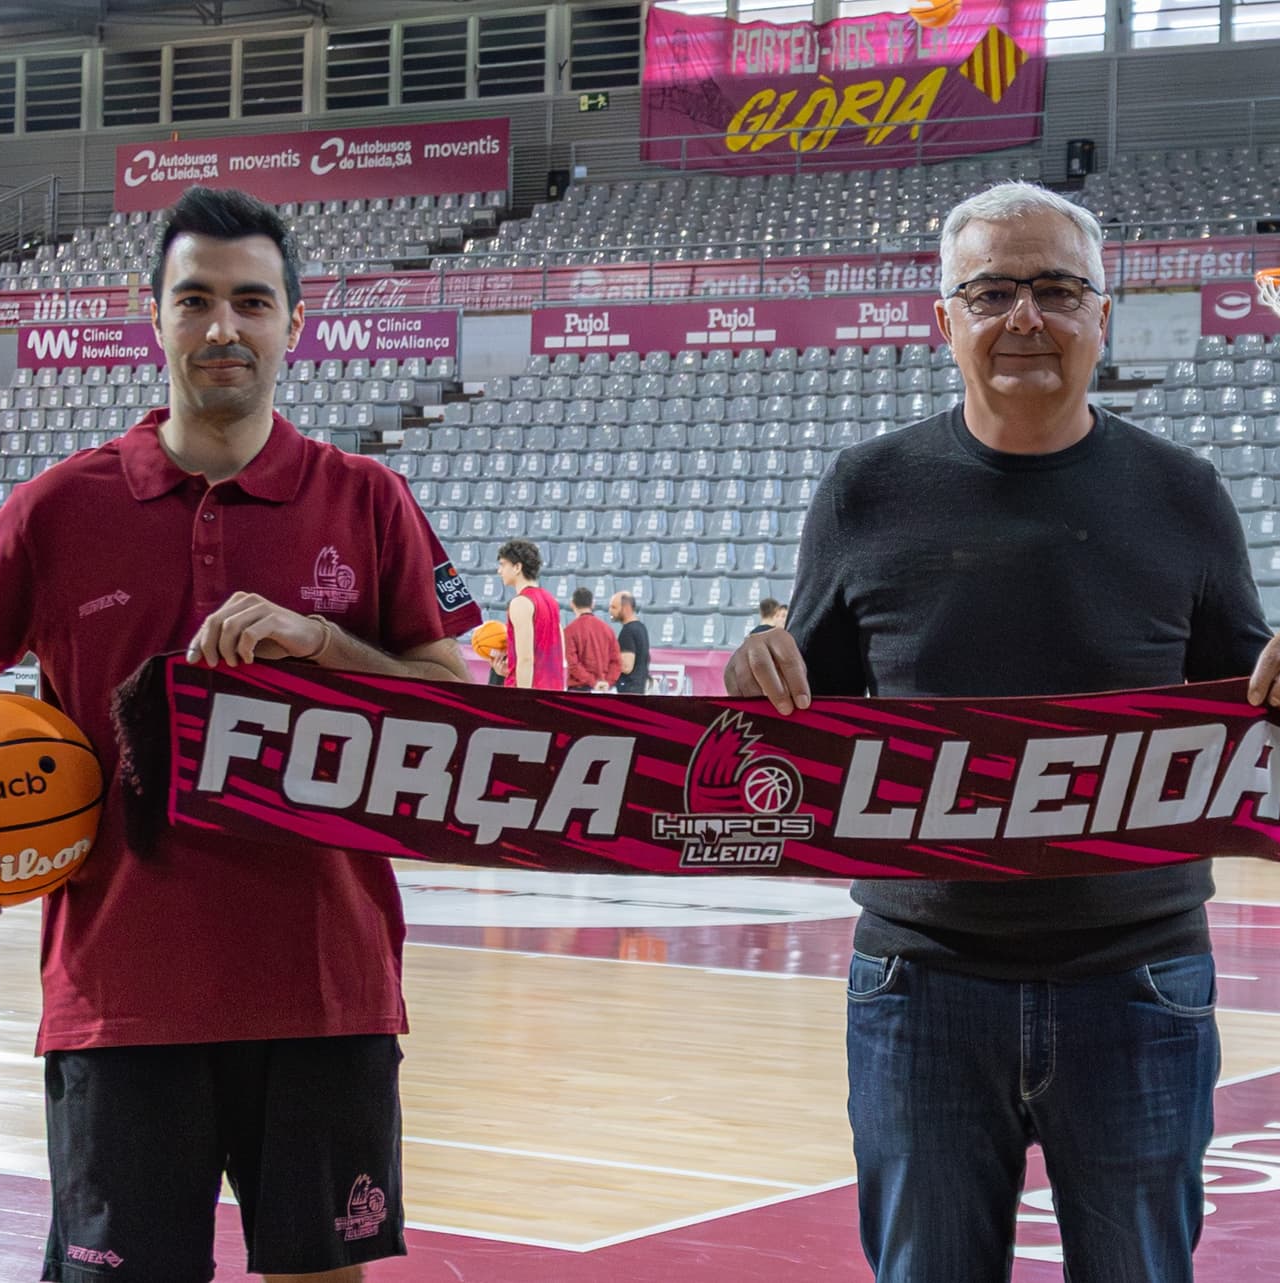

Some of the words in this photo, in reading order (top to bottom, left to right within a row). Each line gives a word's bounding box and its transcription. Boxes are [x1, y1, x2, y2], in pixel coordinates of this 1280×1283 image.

[731, 24, 876, 74] PORTEU-NOS
[725, 67, 948, 152] GLÒRIA
[349, 139, 411, 155] Autobusos
[424, 134, 500, 158] moventis
[158, 153, 218, 168] Autobusos
[229, 150, 300, 171] moventis
[339, 156, 354, 170] de
[150, 168, 165, 181] de
[824, 259, 942, 295] plusfrés
[707, 307, 756, 334] Pujol
[858, 302, 909, 327] Pujol
[376, 317, 422, 333] Clínica
[565, 312, 610, 337] Pujol
[82, 328, 123, 342] Clínica
[376, 335, 450, 351] NovAliança
[82, 344, 149, 359] NovAliança
[436, 577, 463, 594] liga
[197, 692, 636, 845] FORÇA
[686, 845, 779, 863] LLEIDA
